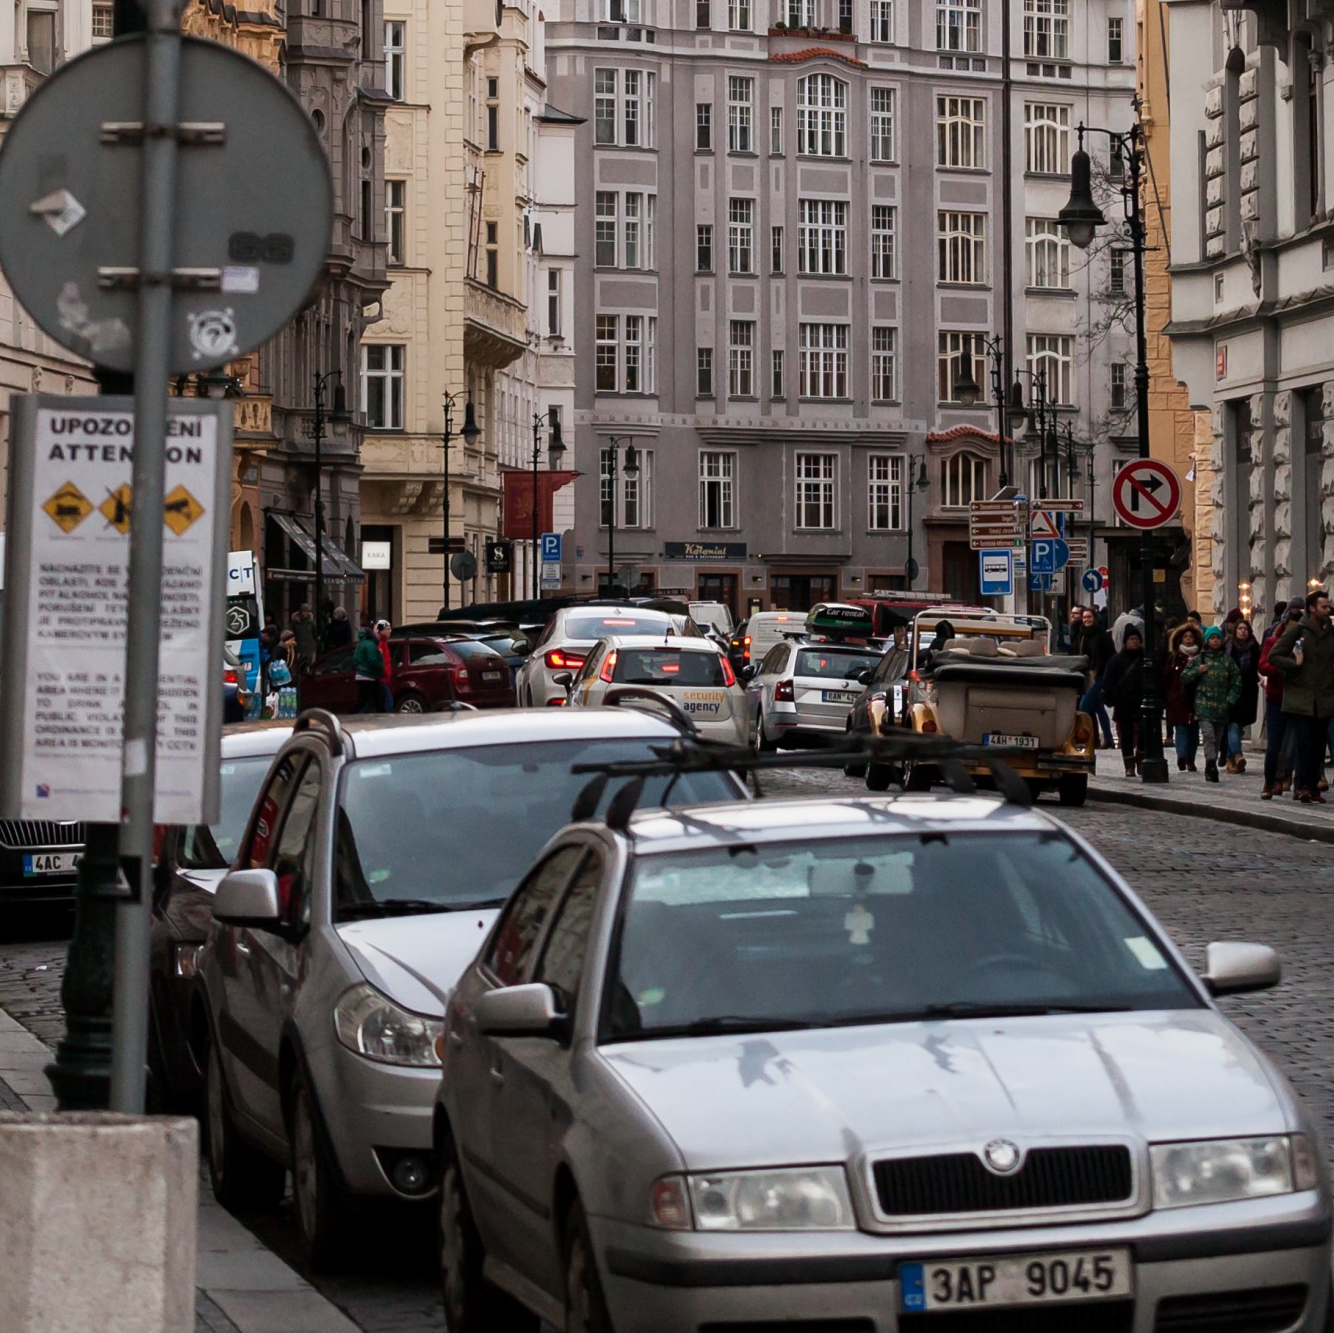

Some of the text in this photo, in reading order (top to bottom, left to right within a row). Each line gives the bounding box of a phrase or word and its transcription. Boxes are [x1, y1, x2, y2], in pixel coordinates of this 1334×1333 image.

[48, 444, 202, 464] ATTENON
[826, 608, 841, 616] Car
[683, 691, 726, 704] security
[683, 702, 720, 714] agency
[990, 735, 1035, 747] 4AH 1931
[35, 855, 61, 871] 4AC
[931, 1254, 1114, 1303] 3AP 9045
